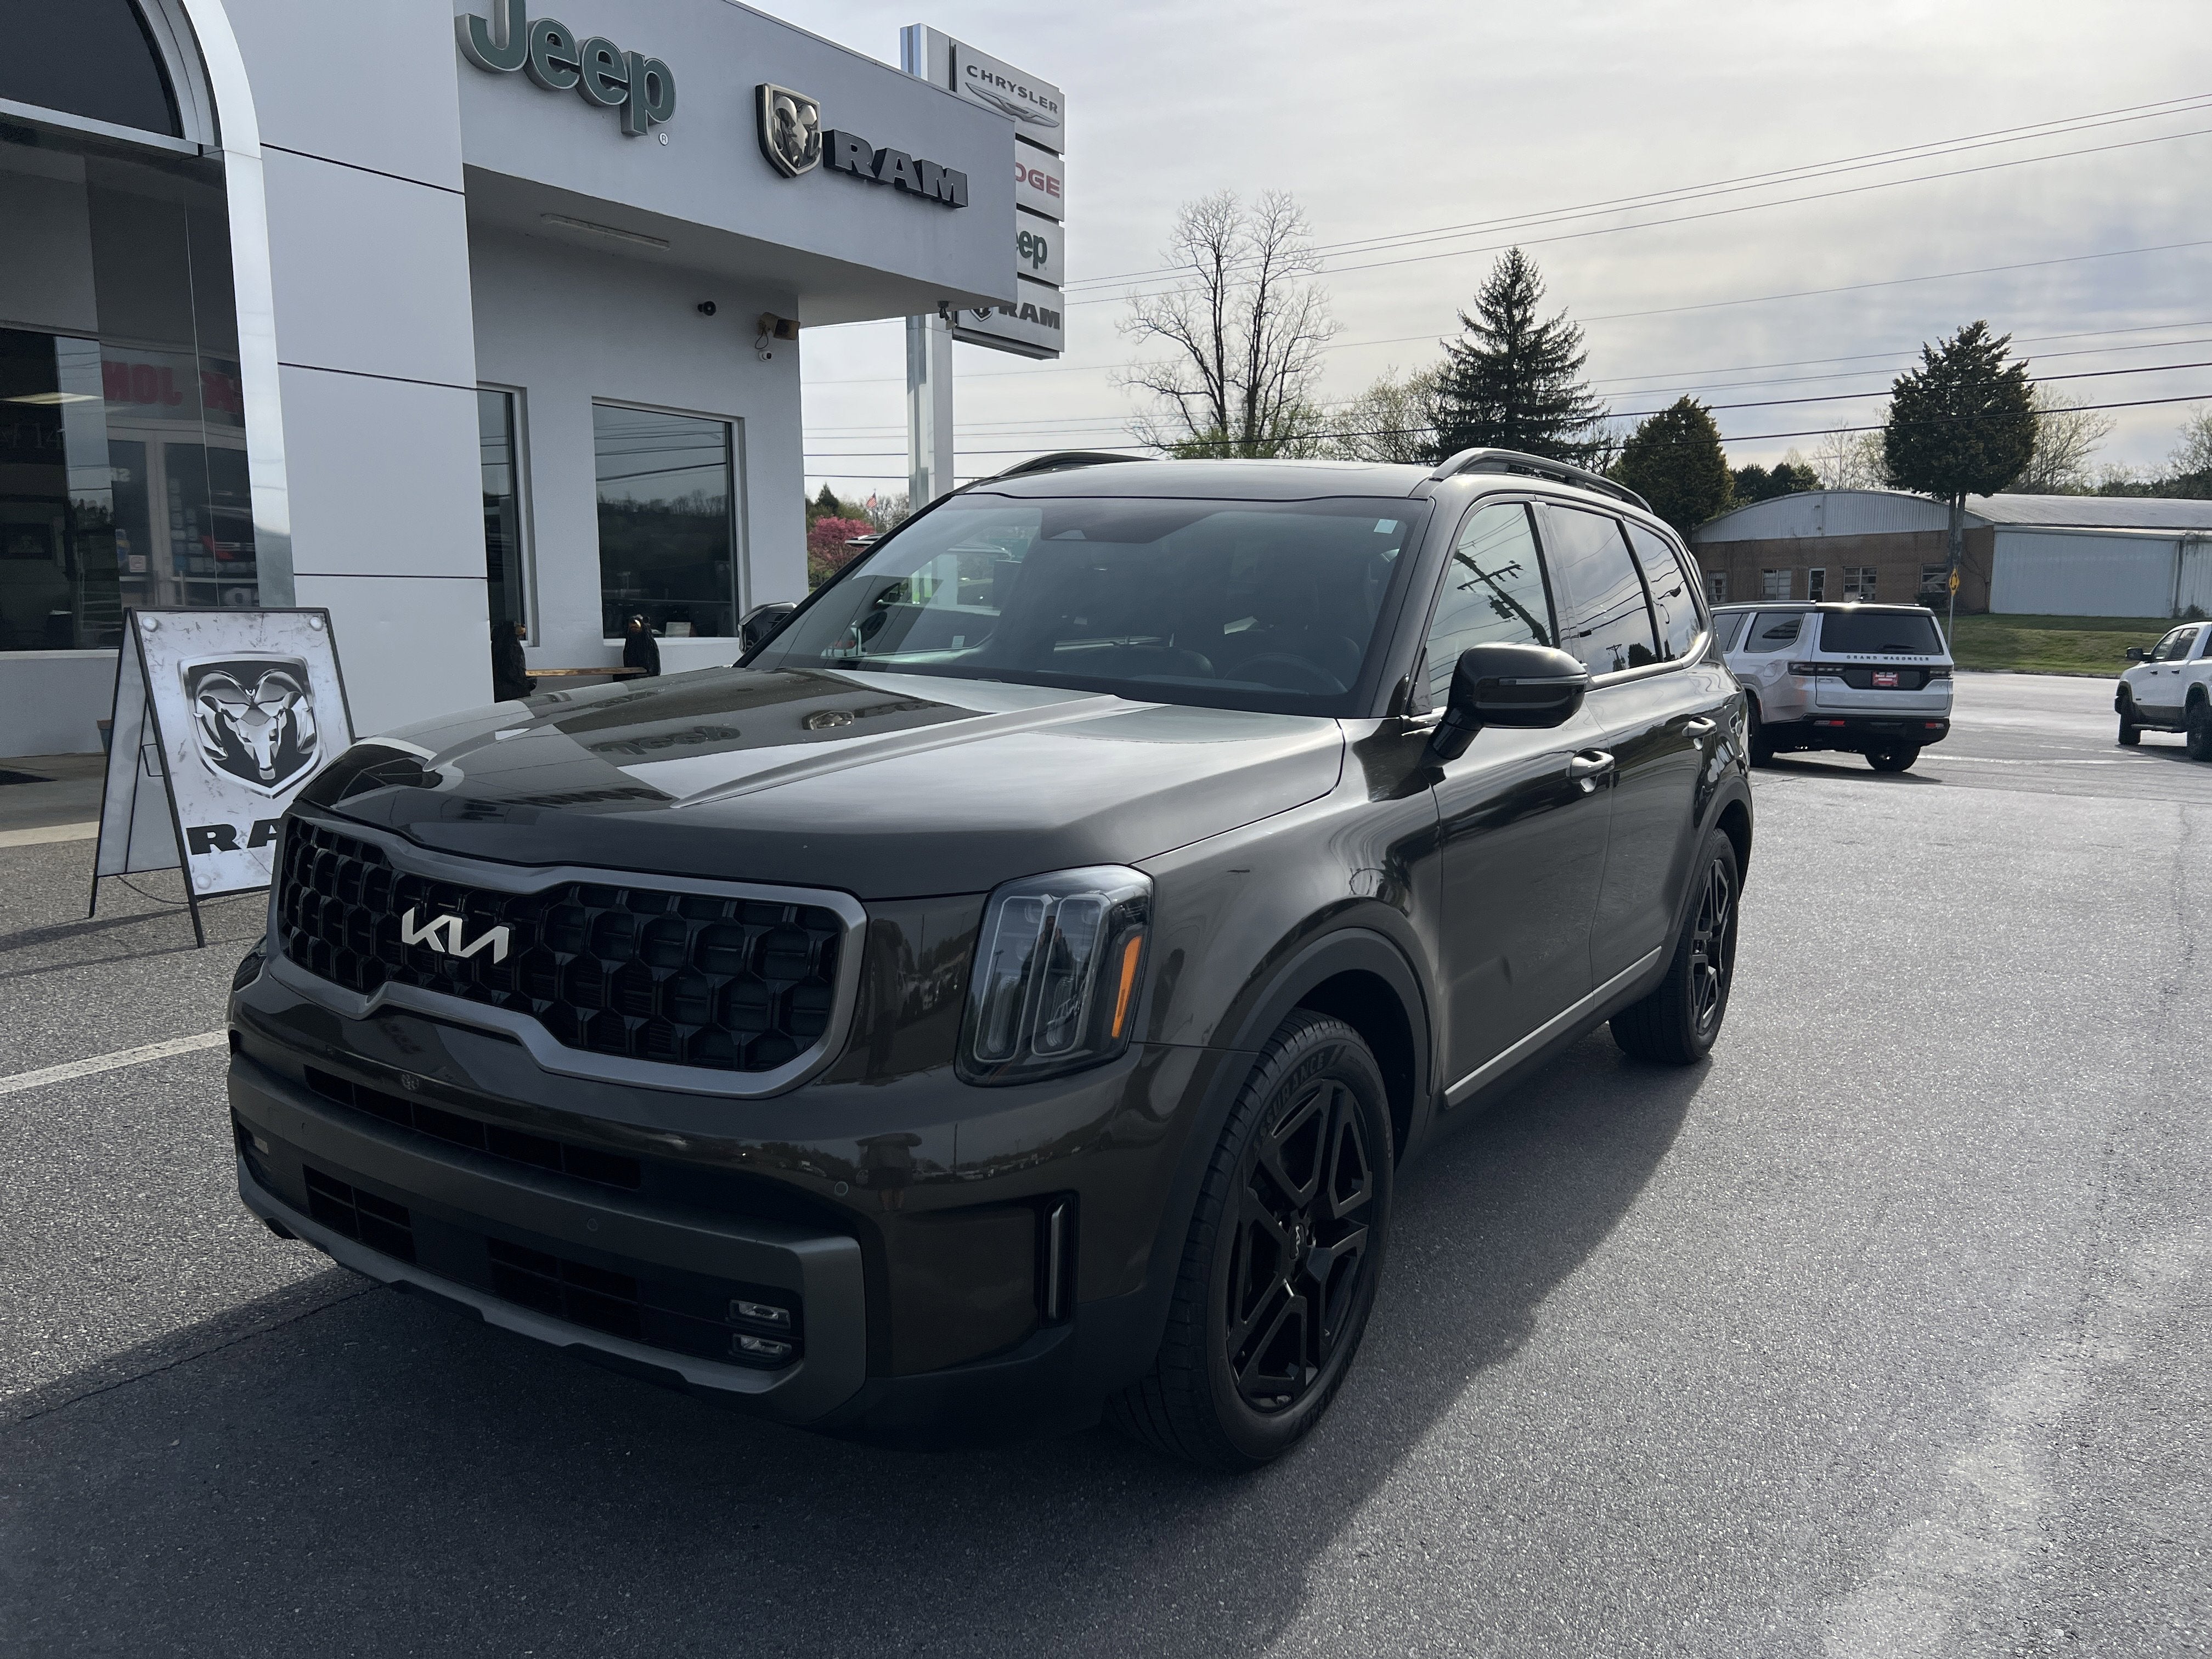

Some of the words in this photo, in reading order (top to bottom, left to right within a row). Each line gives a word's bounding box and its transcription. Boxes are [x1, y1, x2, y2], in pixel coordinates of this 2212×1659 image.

[454, 0, 676, 137] Jeep
[966, 64, 1059, 114] CHRYSLER
[822, 129, 968, 208] RAM
[1015, 162, 1060, 198] DGE
[186, 818, 281, 855] RA
